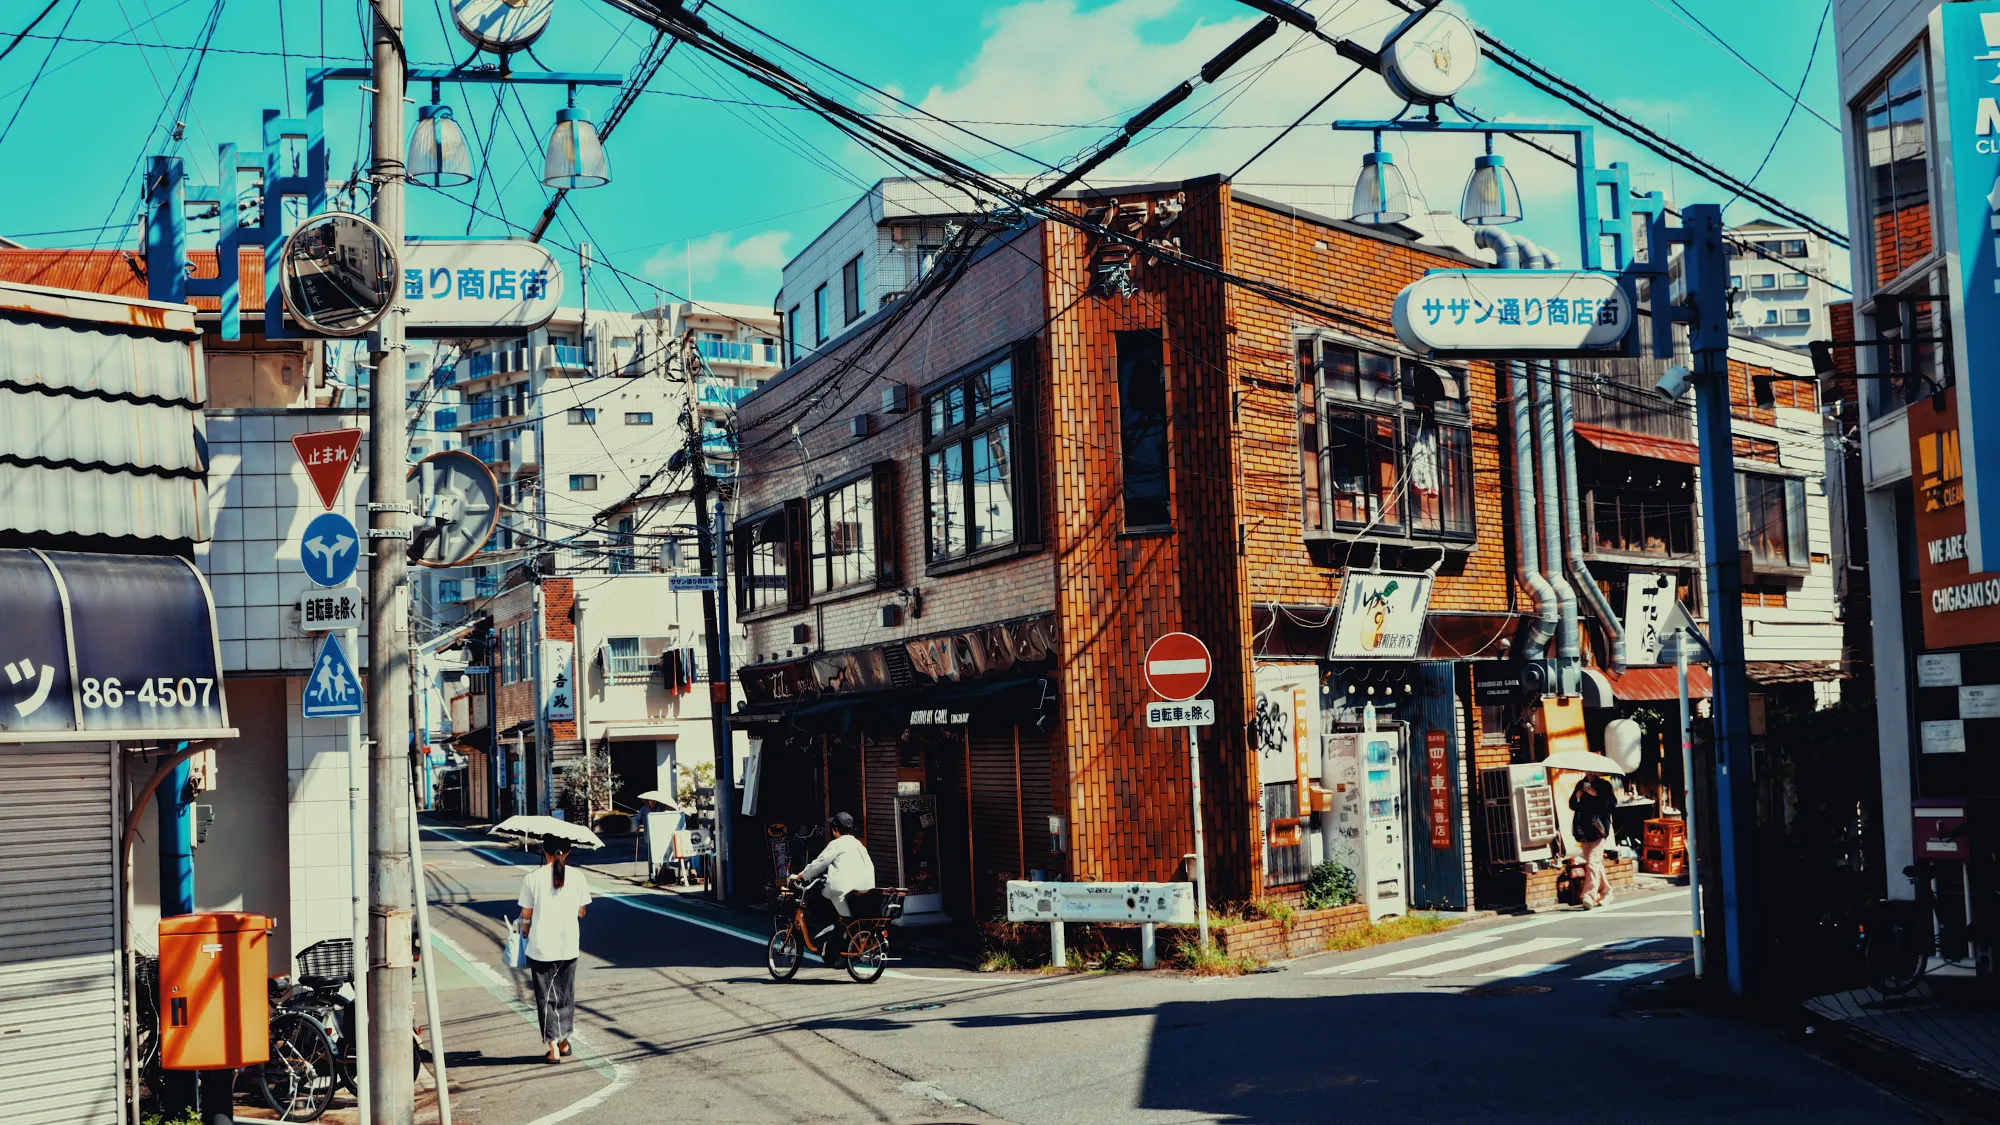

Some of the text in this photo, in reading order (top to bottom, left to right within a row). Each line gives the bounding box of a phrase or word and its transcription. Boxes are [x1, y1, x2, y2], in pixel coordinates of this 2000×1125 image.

[1976, 139, 2000, 155] CL
[1422, 297, 1619, 326] サザン通り商店街
[308, 445, 348, 466] 止まれ
[1928, 539, 1944, 564] WE
[1945, 535, 1963, 561] ARE
[306, 596, 357, 621] 自転車を除く
[1932, 578, 2000, 613] CHIGASAKI SO
[4, 658, 55, 718] ツ
[82, 677, 214, 708] 86-4507
[1150, 706, 1210, 722] 自転車を除く
